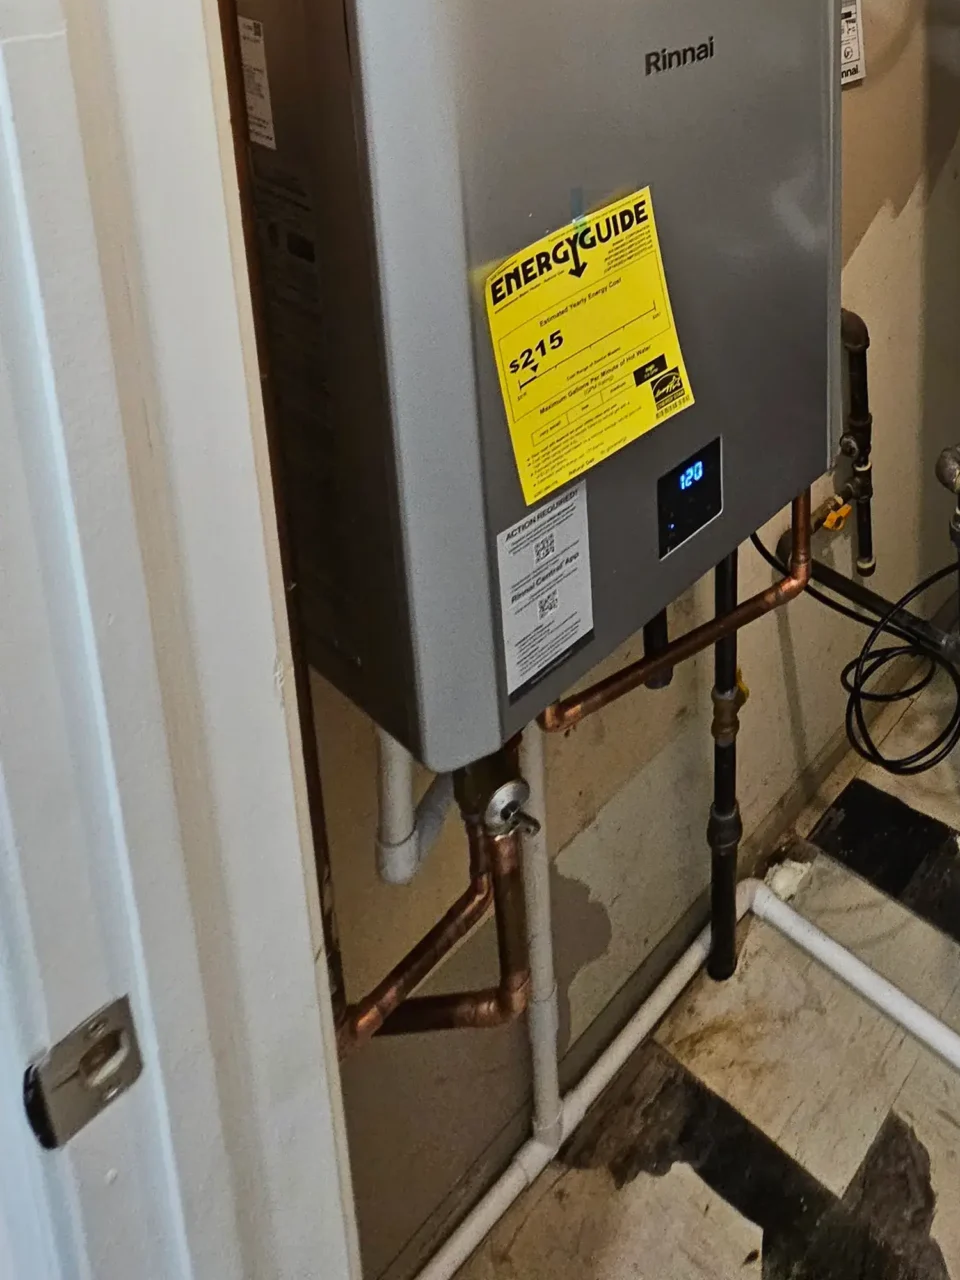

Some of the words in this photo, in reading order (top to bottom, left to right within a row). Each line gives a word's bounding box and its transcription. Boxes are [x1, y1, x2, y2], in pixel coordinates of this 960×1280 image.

[645, 35, 714, 76] Rinnai
[841, 64, 859, 79] nnai
[491, 200, 648, 306] ENERGYGUIDE
[540, 307, 568, 327] Estimated
[569, 297, 587, 310] Yearly
[588, 287, 608, 300] Energy
[609, 277, 622, 288] Cost
[509, 330, 564, 374] $215
[680, 461, 703, 490] 120
[506, 516, 536, 541] ACTION
